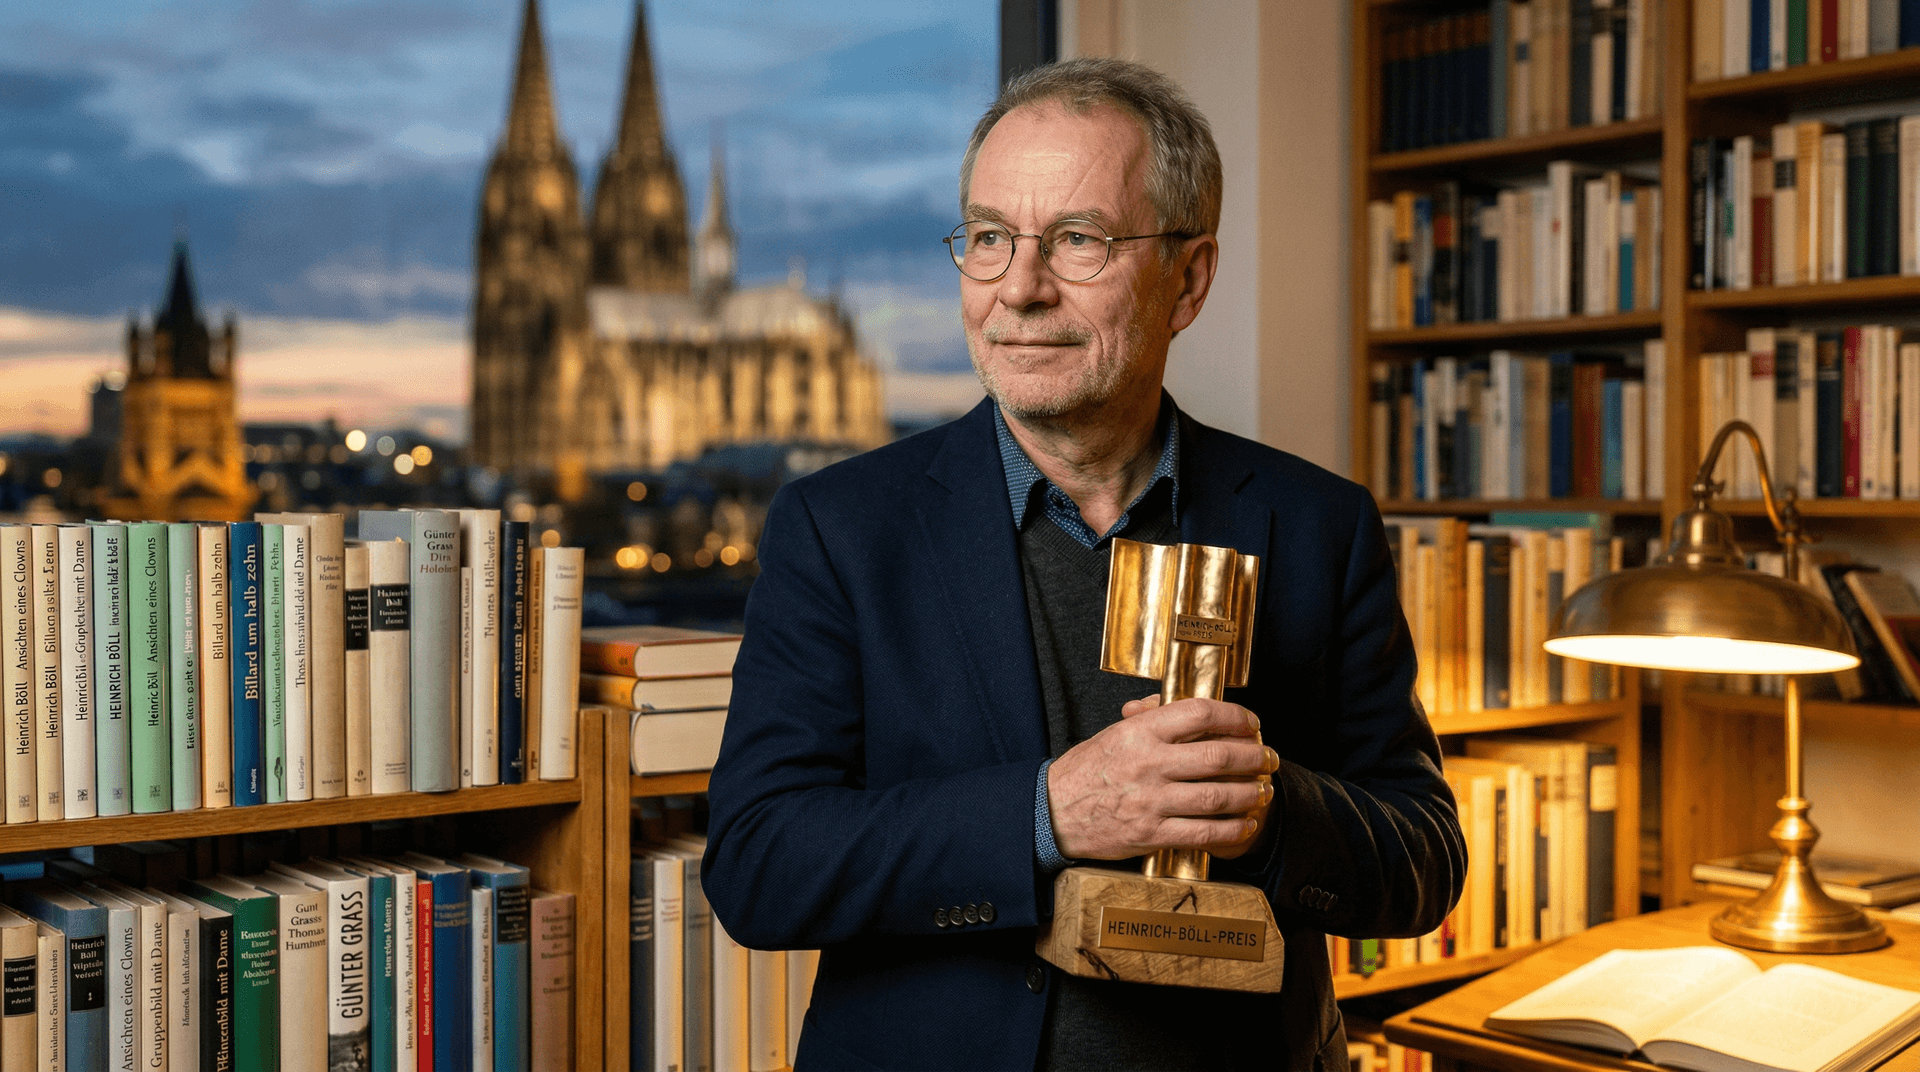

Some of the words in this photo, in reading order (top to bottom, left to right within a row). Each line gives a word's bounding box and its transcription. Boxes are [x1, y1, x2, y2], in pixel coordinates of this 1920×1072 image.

[423, 529, 456, 540] Günter
[14, 540, 26, 583] Clowns
[73, 540, 84, 572] Dame
[145, 538, 156, 576] Clowns
[244, 544, 256, 581] zehn
[294, 537, 304, 568] Dame
[212, 572, 222, 596] halb
[14, 586, 26, 615] eines
[216, 601, 223, 619] um
[244, 585, 257, 618] halb
[15, 618, 28, 670] Ansichten
[106, 632, 120, 660] BÖLL
[212, 623, 224, 660] Billard
[248, 622, 257, 646] um
[44, 665, 57, 689] Böll
[245, 651, 258, 700] Billard
[14, 682, 28, 706] Böll
[109, 664, 122, 720] HEINRICH
[45, 692, 58, 738] Heinrich
[16, 708, 30, 755] Heinrich
[295, 903, 318, 914] Gunt
[341, 890, 363, 946] GRASS
[71, 939, 105, 950] Heinrich
[121, 927, 133, 970] Clowns
[151, 922, 162, 958] Dame
[288, 927, 325, 938] Thomas
[1108, 920, 1257, 947] HEINRICH-BÖLL-PREIS
[216, 929, 228, 969] Dame
[151, 962, 162, 984] mit
[217, 972, 228, 994] mit
[336, 950, 363, 1019] GÜNTER
[121, 974, 133, 1006] eines
[150, 987, 165, 1068] Gruppenbild
